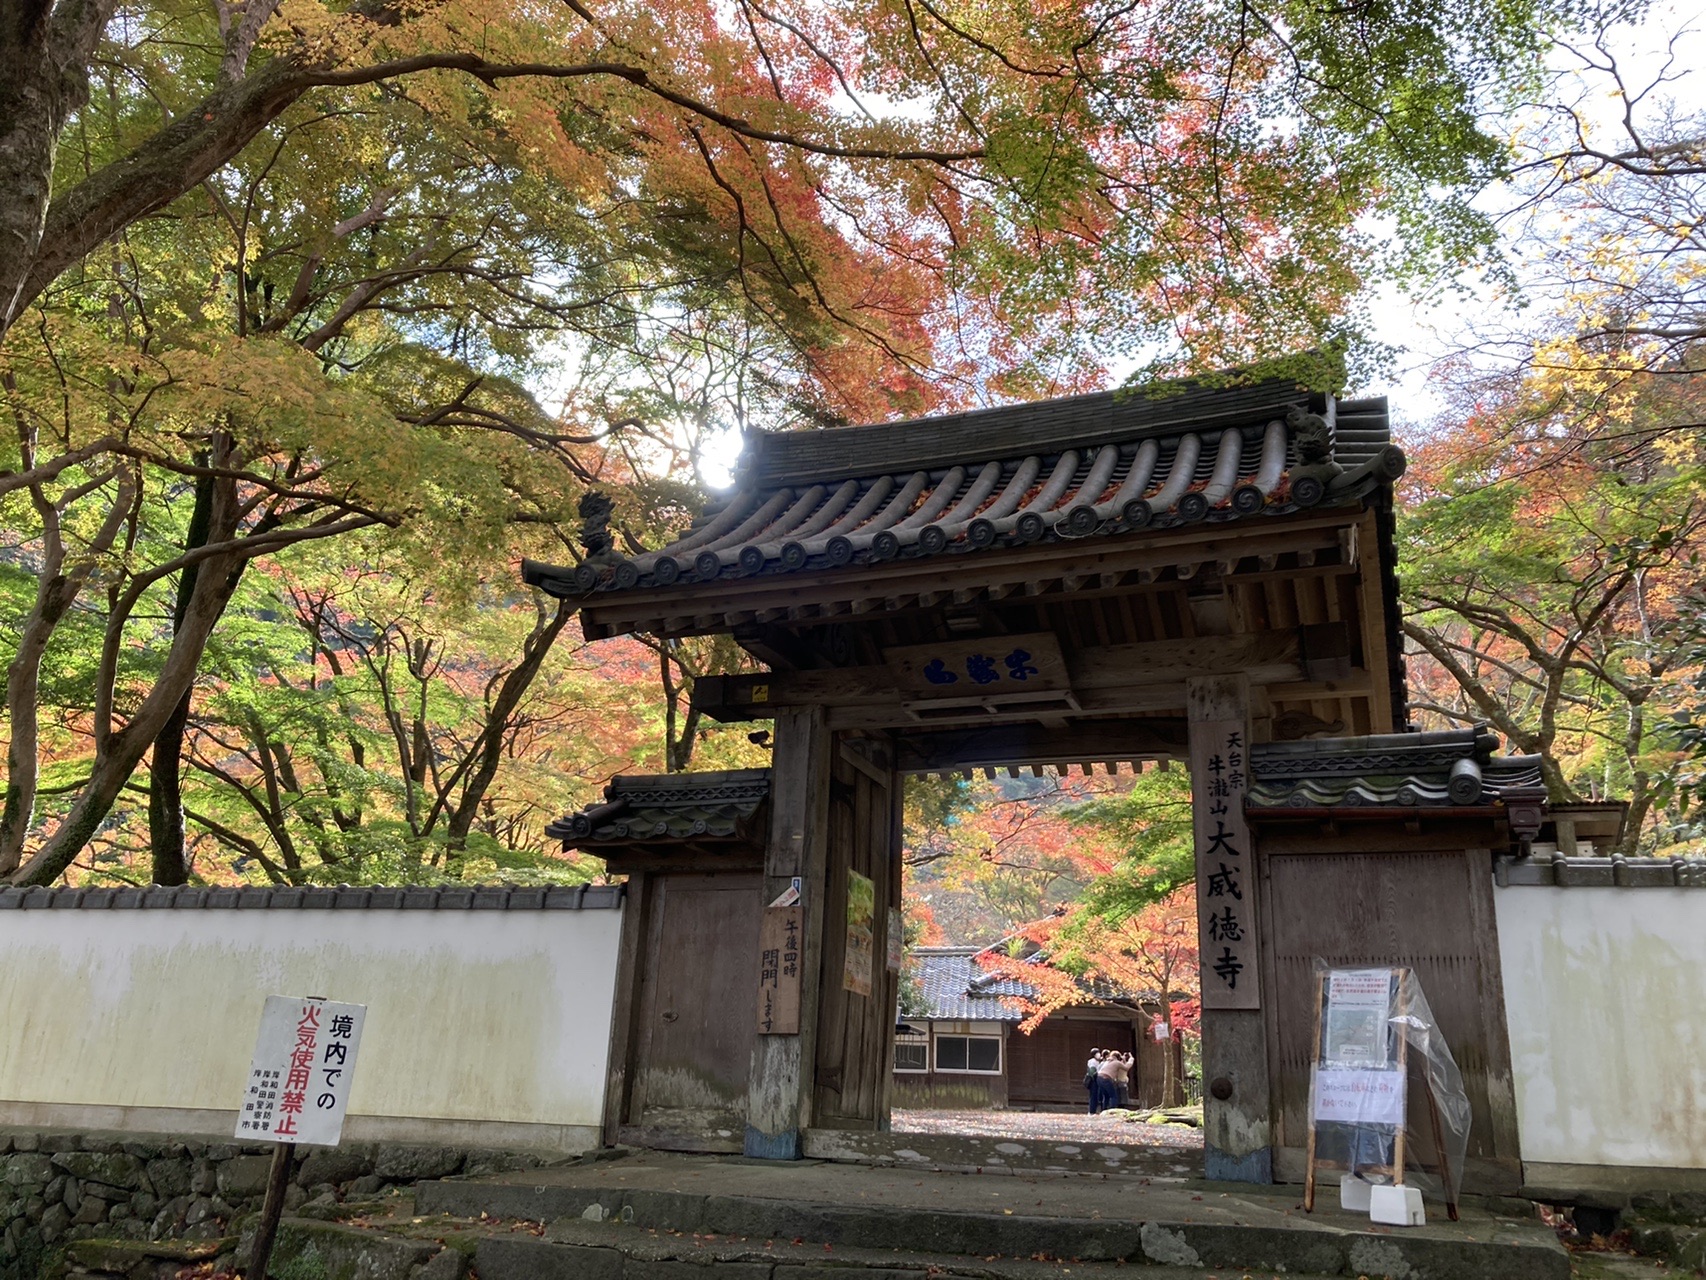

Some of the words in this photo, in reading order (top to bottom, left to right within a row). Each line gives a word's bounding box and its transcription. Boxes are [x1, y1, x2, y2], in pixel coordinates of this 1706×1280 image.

[1226, 732, 1245, 790] 天台宗
[783, 919, 799, 979] 午後四時
[760, 949, 780, 1033] 閉門します
[274, 1004, 322, 1136] 火気使用禁止
[317, 1014, 353, 1110] 境内での
[241, 1069, 262, 1129] 岸和田市
[251, 1069, 271, 1130] 岸和田警察署
[261, 1070, 280, 1131] 岸和田消防署
